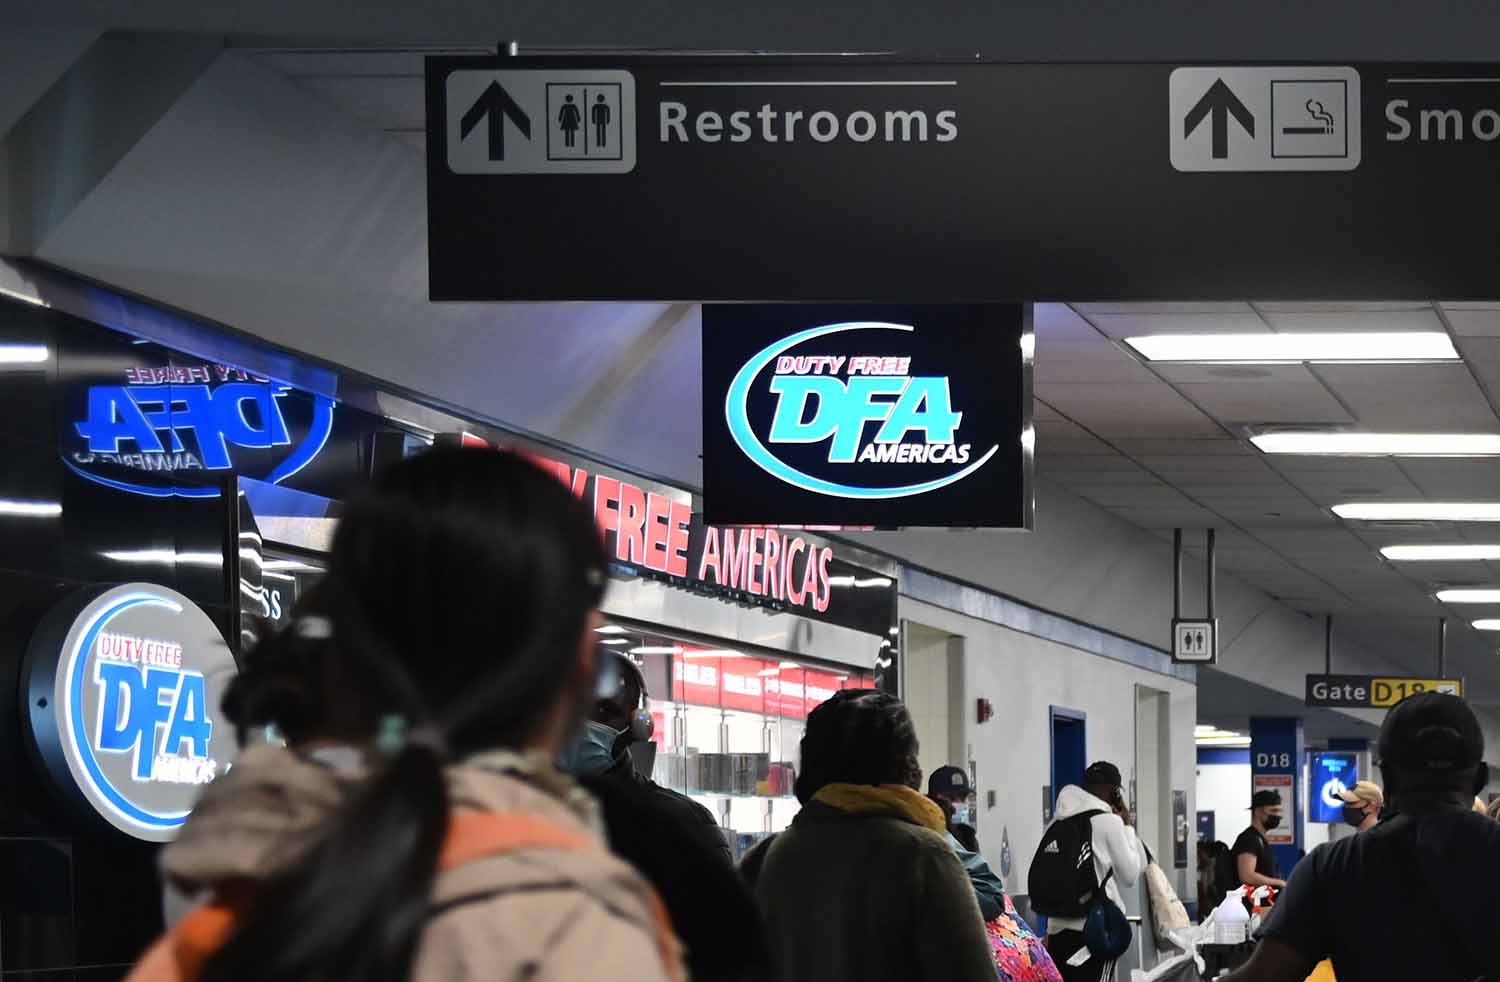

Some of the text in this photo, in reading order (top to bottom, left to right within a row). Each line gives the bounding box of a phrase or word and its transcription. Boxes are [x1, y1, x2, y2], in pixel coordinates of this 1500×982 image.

[659, 101, 959, 143] Restrooms
[775, 356, 912, 376] DUTY FREE
[768, 375, 963, 464] DFA
[858, 443, 972, 464] AMERICAS
[593, 474, 833, 613] FREE AMERICAS
[99, 635, 184, 668] DUTY FREE
[1312, 682, 1366, 700] Gate
[94, 658, 213, 782] DFA
[1256, 753, 1291, 769] D18
